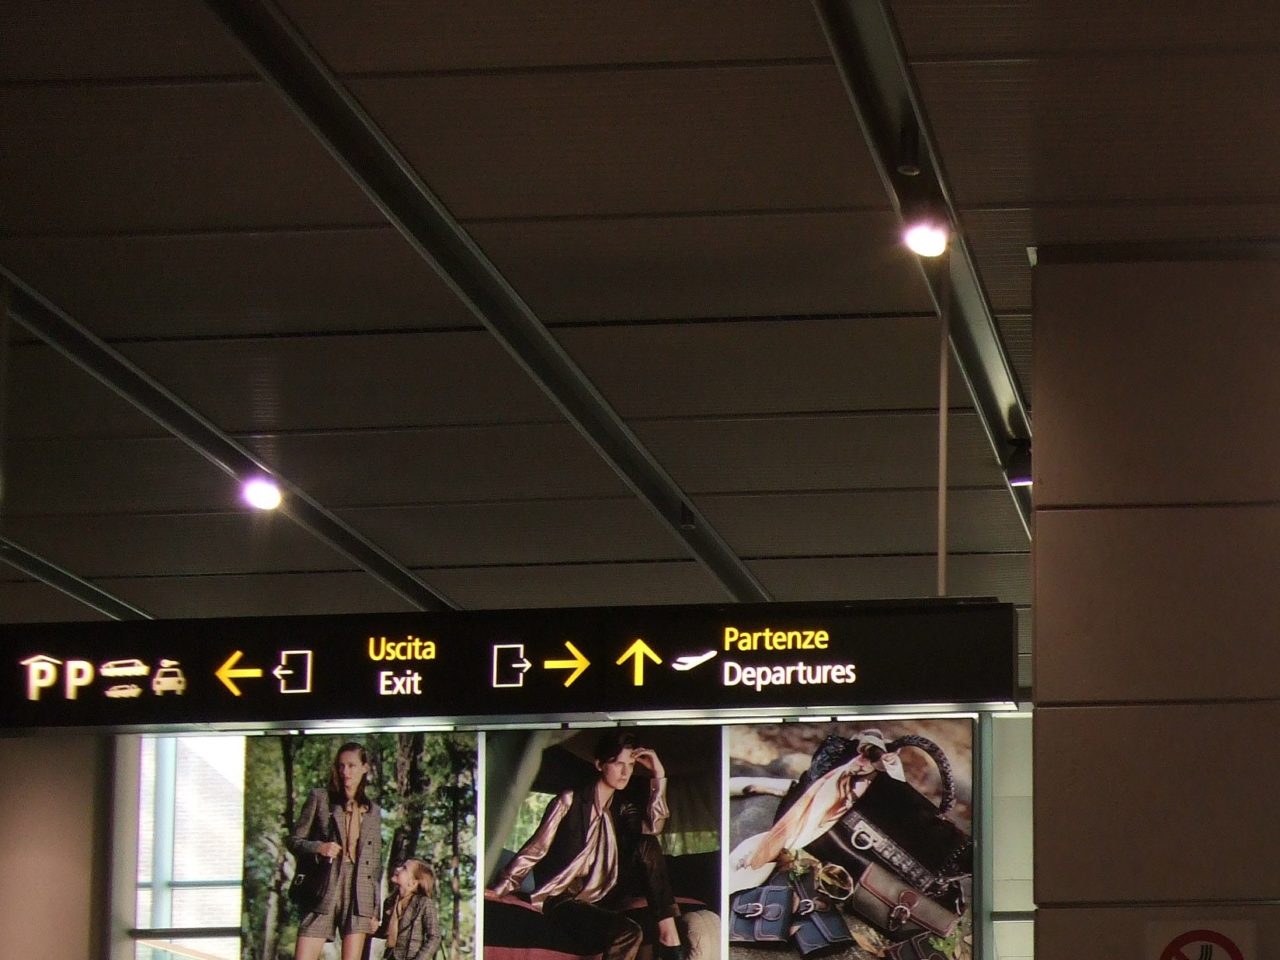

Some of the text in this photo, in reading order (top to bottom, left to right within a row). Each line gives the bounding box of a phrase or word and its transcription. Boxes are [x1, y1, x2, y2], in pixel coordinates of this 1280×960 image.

[369, 636, 436, 661] Uscita
[724, 626, 830, 651] Partenze
[379, 670, 423, 696] Exit
[723, 660, 857, 692] Departures
